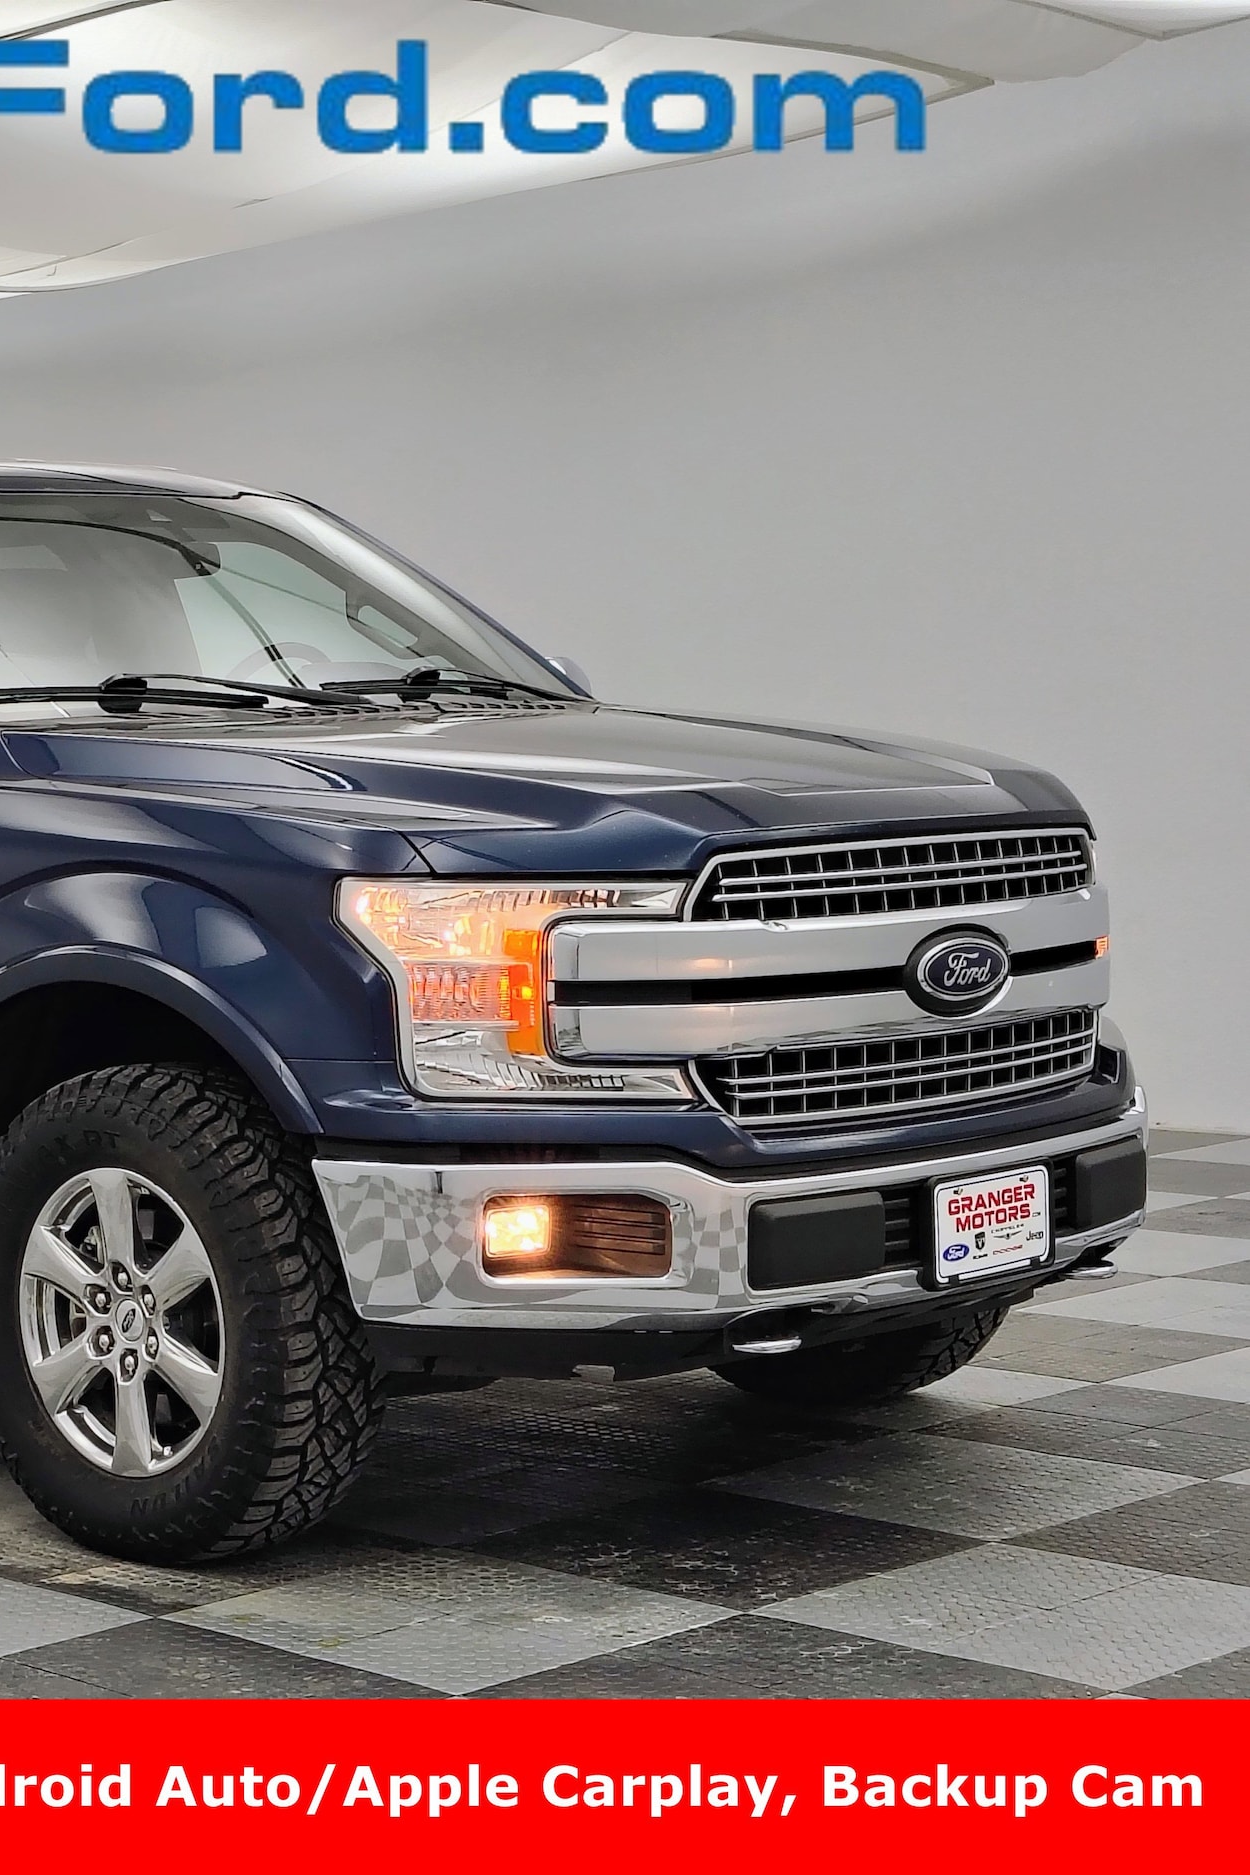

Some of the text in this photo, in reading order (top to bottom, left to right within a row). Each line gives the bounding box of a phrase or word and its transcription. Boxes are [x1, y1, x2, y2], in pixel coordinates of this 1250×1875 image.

[944, 952, 991, 986] Ford
[947, 1183, 1035, 1216] GRANGER
[956, 1203, 1031, 1233] MOTORS
